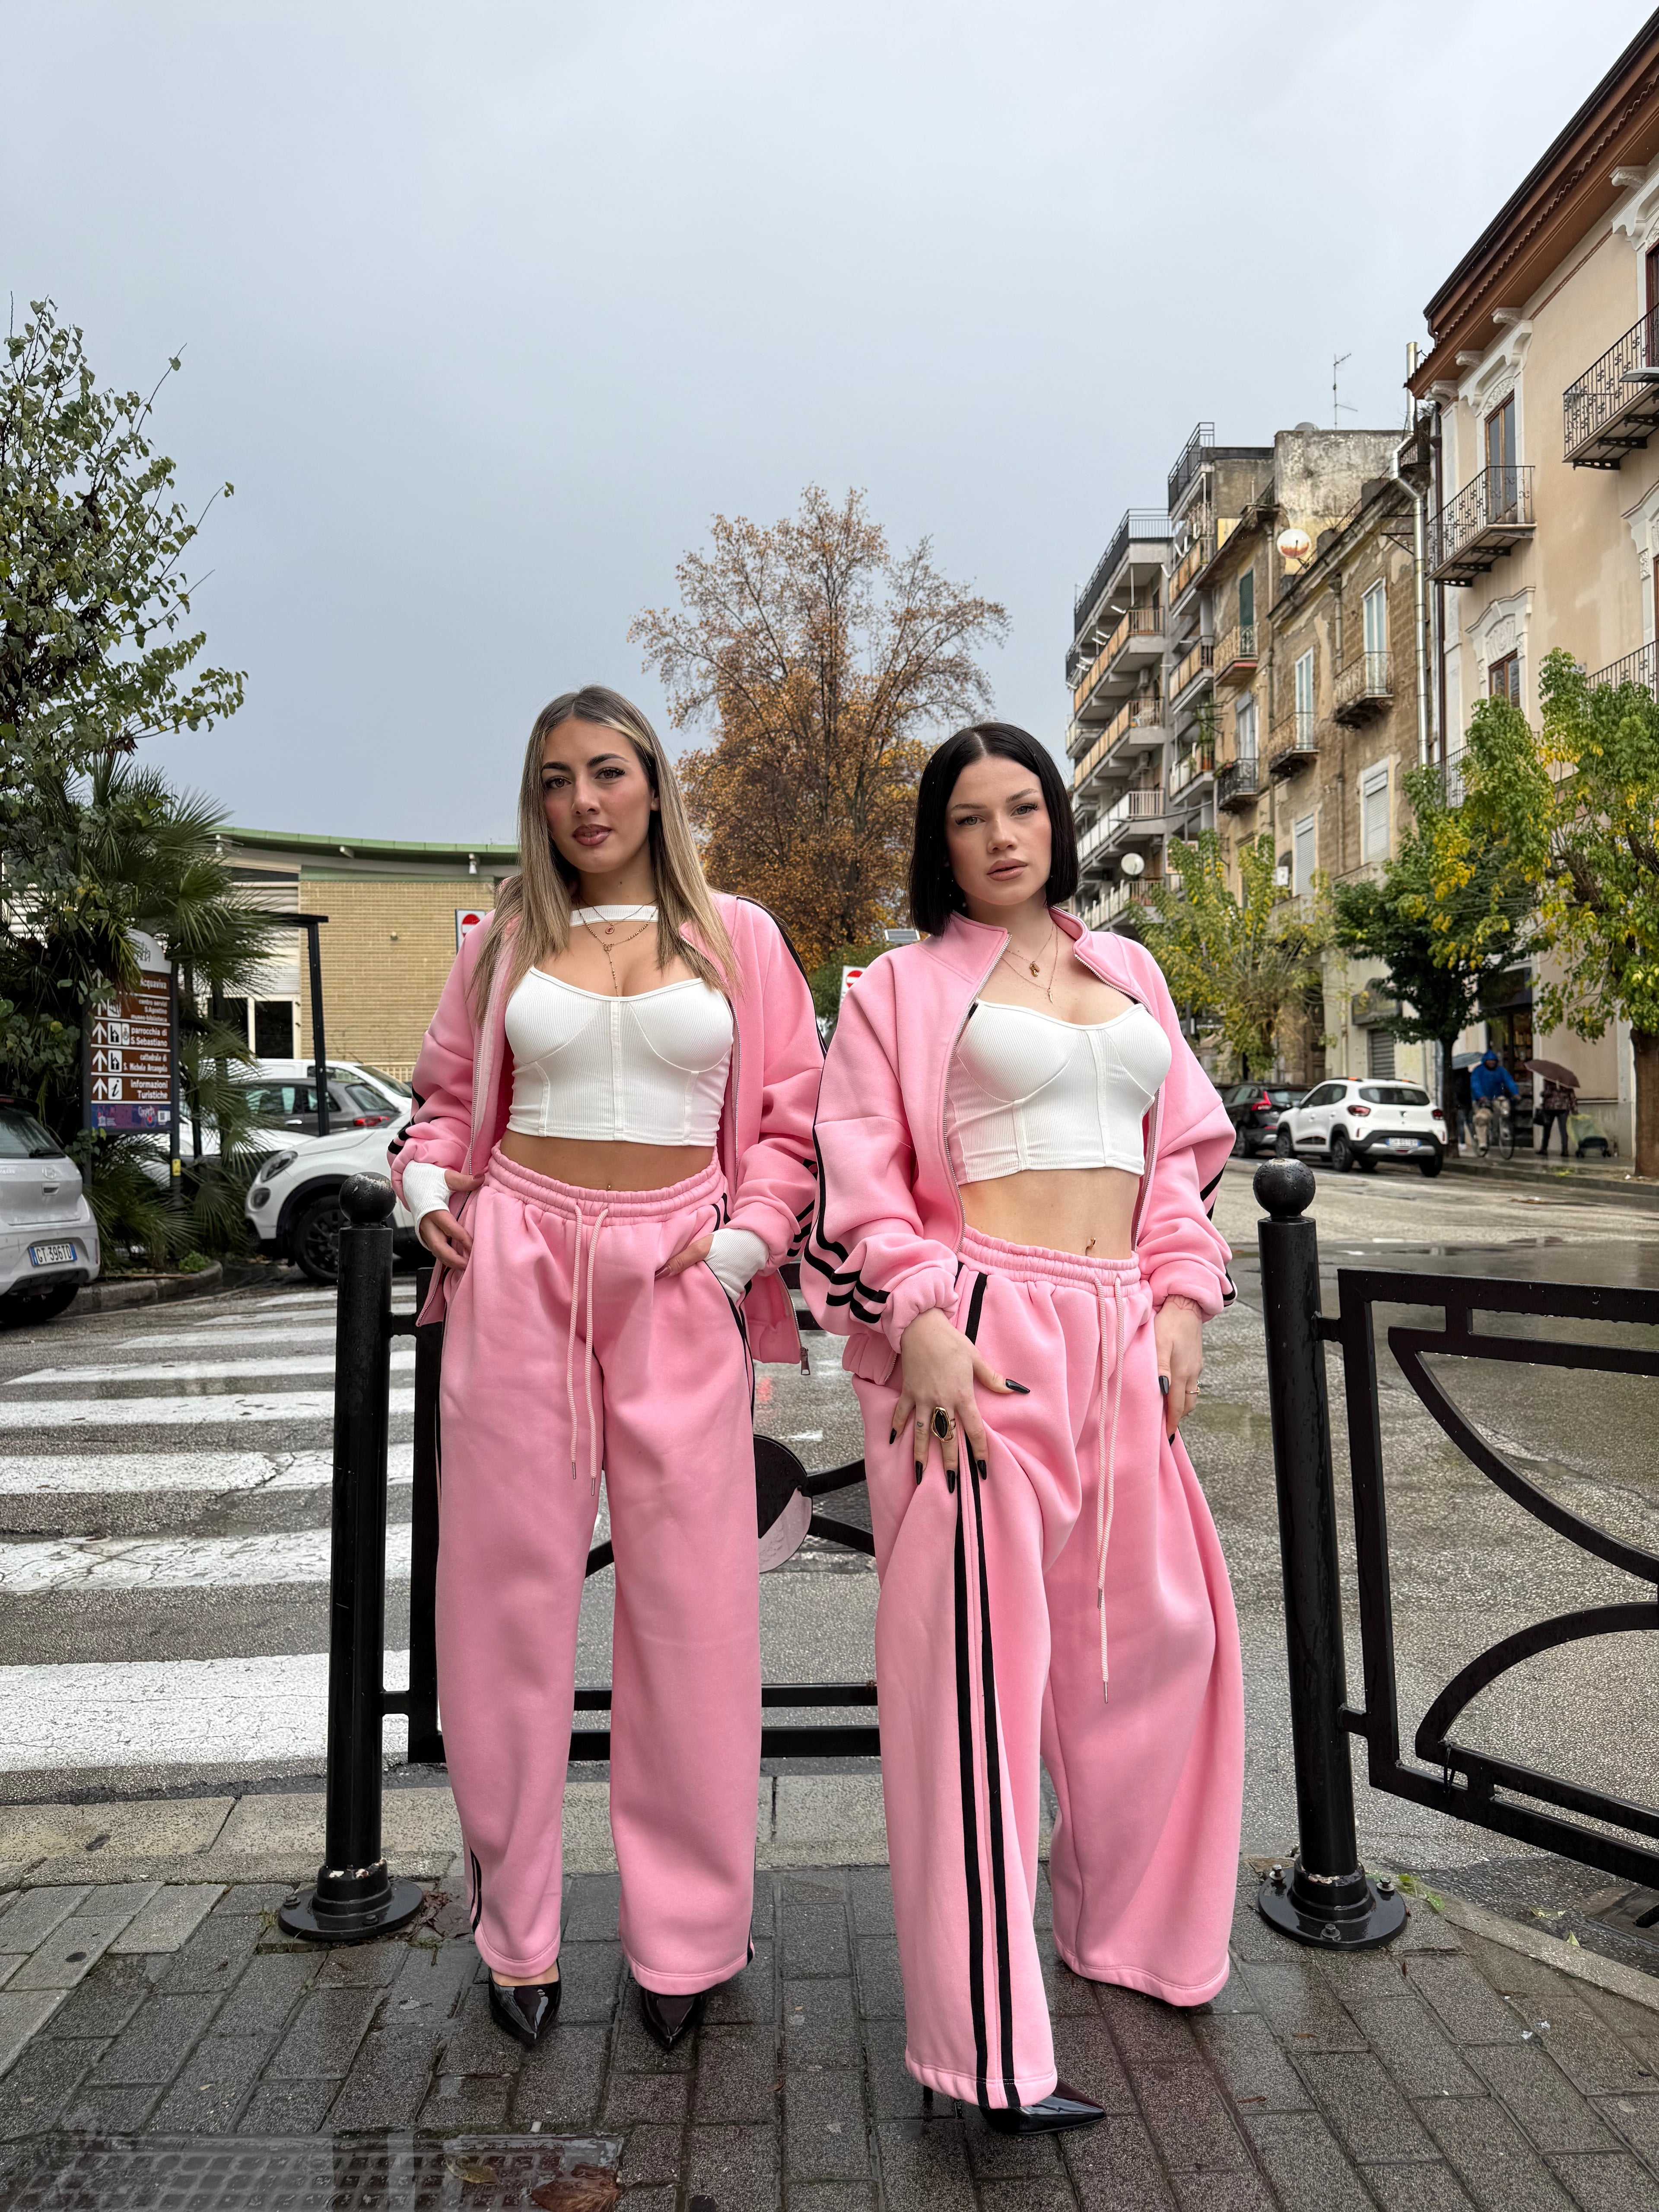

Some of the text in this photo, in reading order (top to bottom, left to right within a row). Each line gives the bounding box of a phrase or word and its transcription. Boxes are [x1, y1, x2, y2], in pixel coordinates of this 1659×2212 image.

[140, 978, 167, 990] Acquaviva
[131, 1027, 167, 1036] parrocchia di
[130, 1036, 168, 1047] S.Sebastiano
[140, 1053, 167, 1062] cattedrale di
[130, 1063, 146, 1071] Michele
[147, 1063, 168, 1074] Arcangelo
[130, 1079, 168, 1089] Informazioni
[137, 1090, 168, 1099] Turistiche
[36, 1248, 47, 1262] GT
